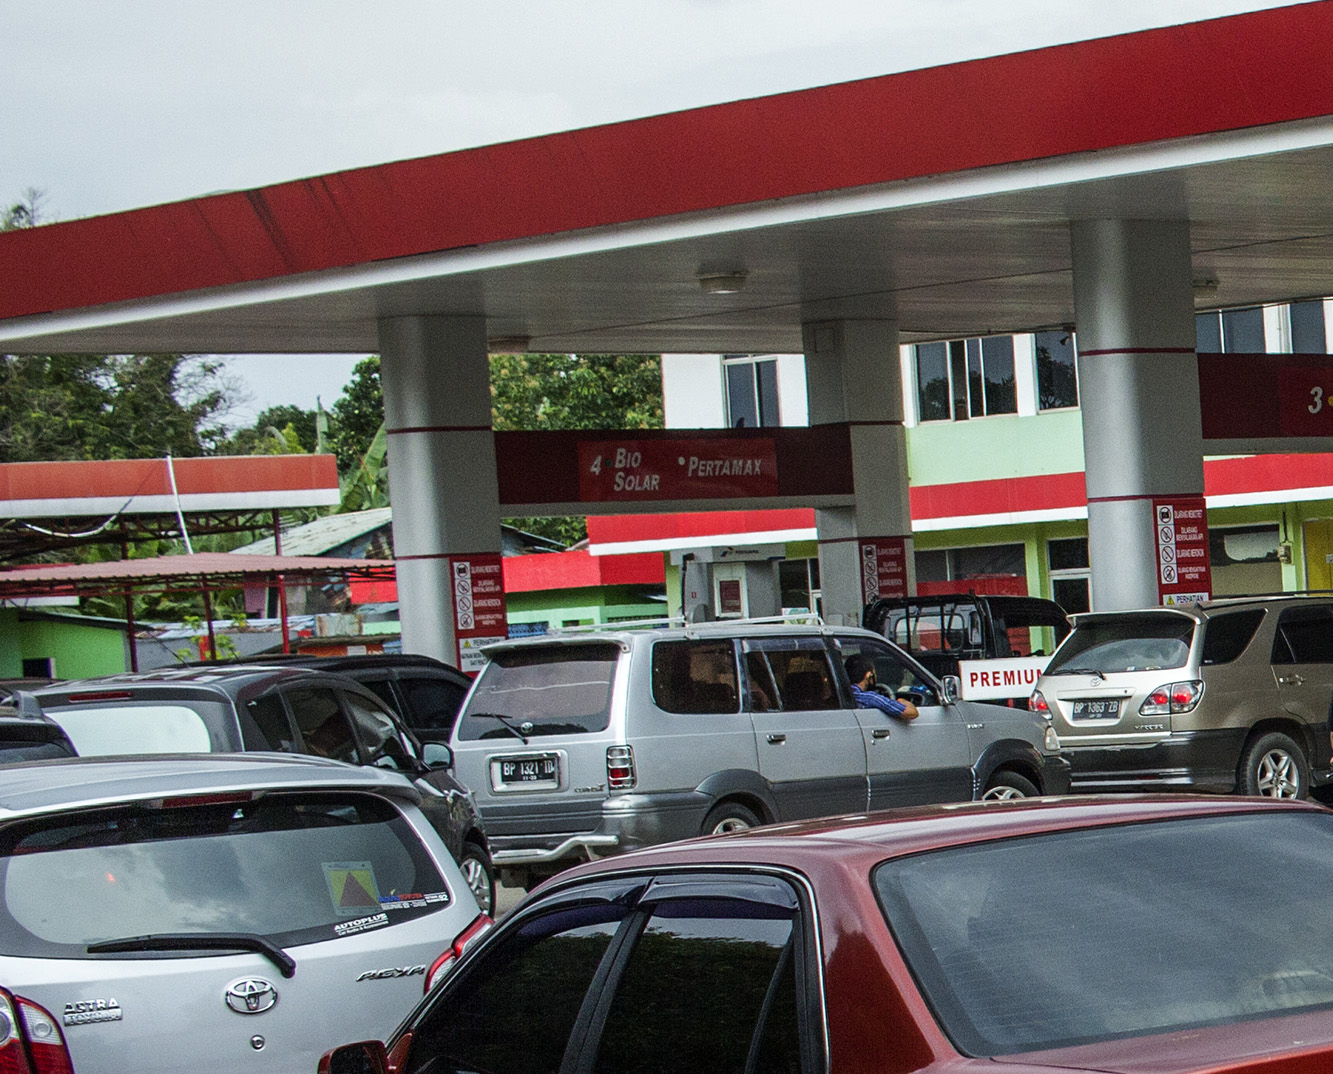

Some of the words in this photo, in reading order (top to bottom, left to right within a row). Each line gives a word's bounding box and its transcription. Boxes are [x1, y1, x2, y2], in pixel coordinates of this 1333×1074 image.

[1308, 386, 1323, 414] 3
[589, 455, 602, 475] 4
[688, 456, 762, 477] PERTAMAX
[613, 472, 660, 491] SOLAR
[503, 762, 515, 776] BP
[521, 761, 539, 775] 1321
[334, 912, 389, 931] AUTOPLUS
[355, 964, 426, 982] AGYA
[64, 997, 120, 1014] ASTRA
